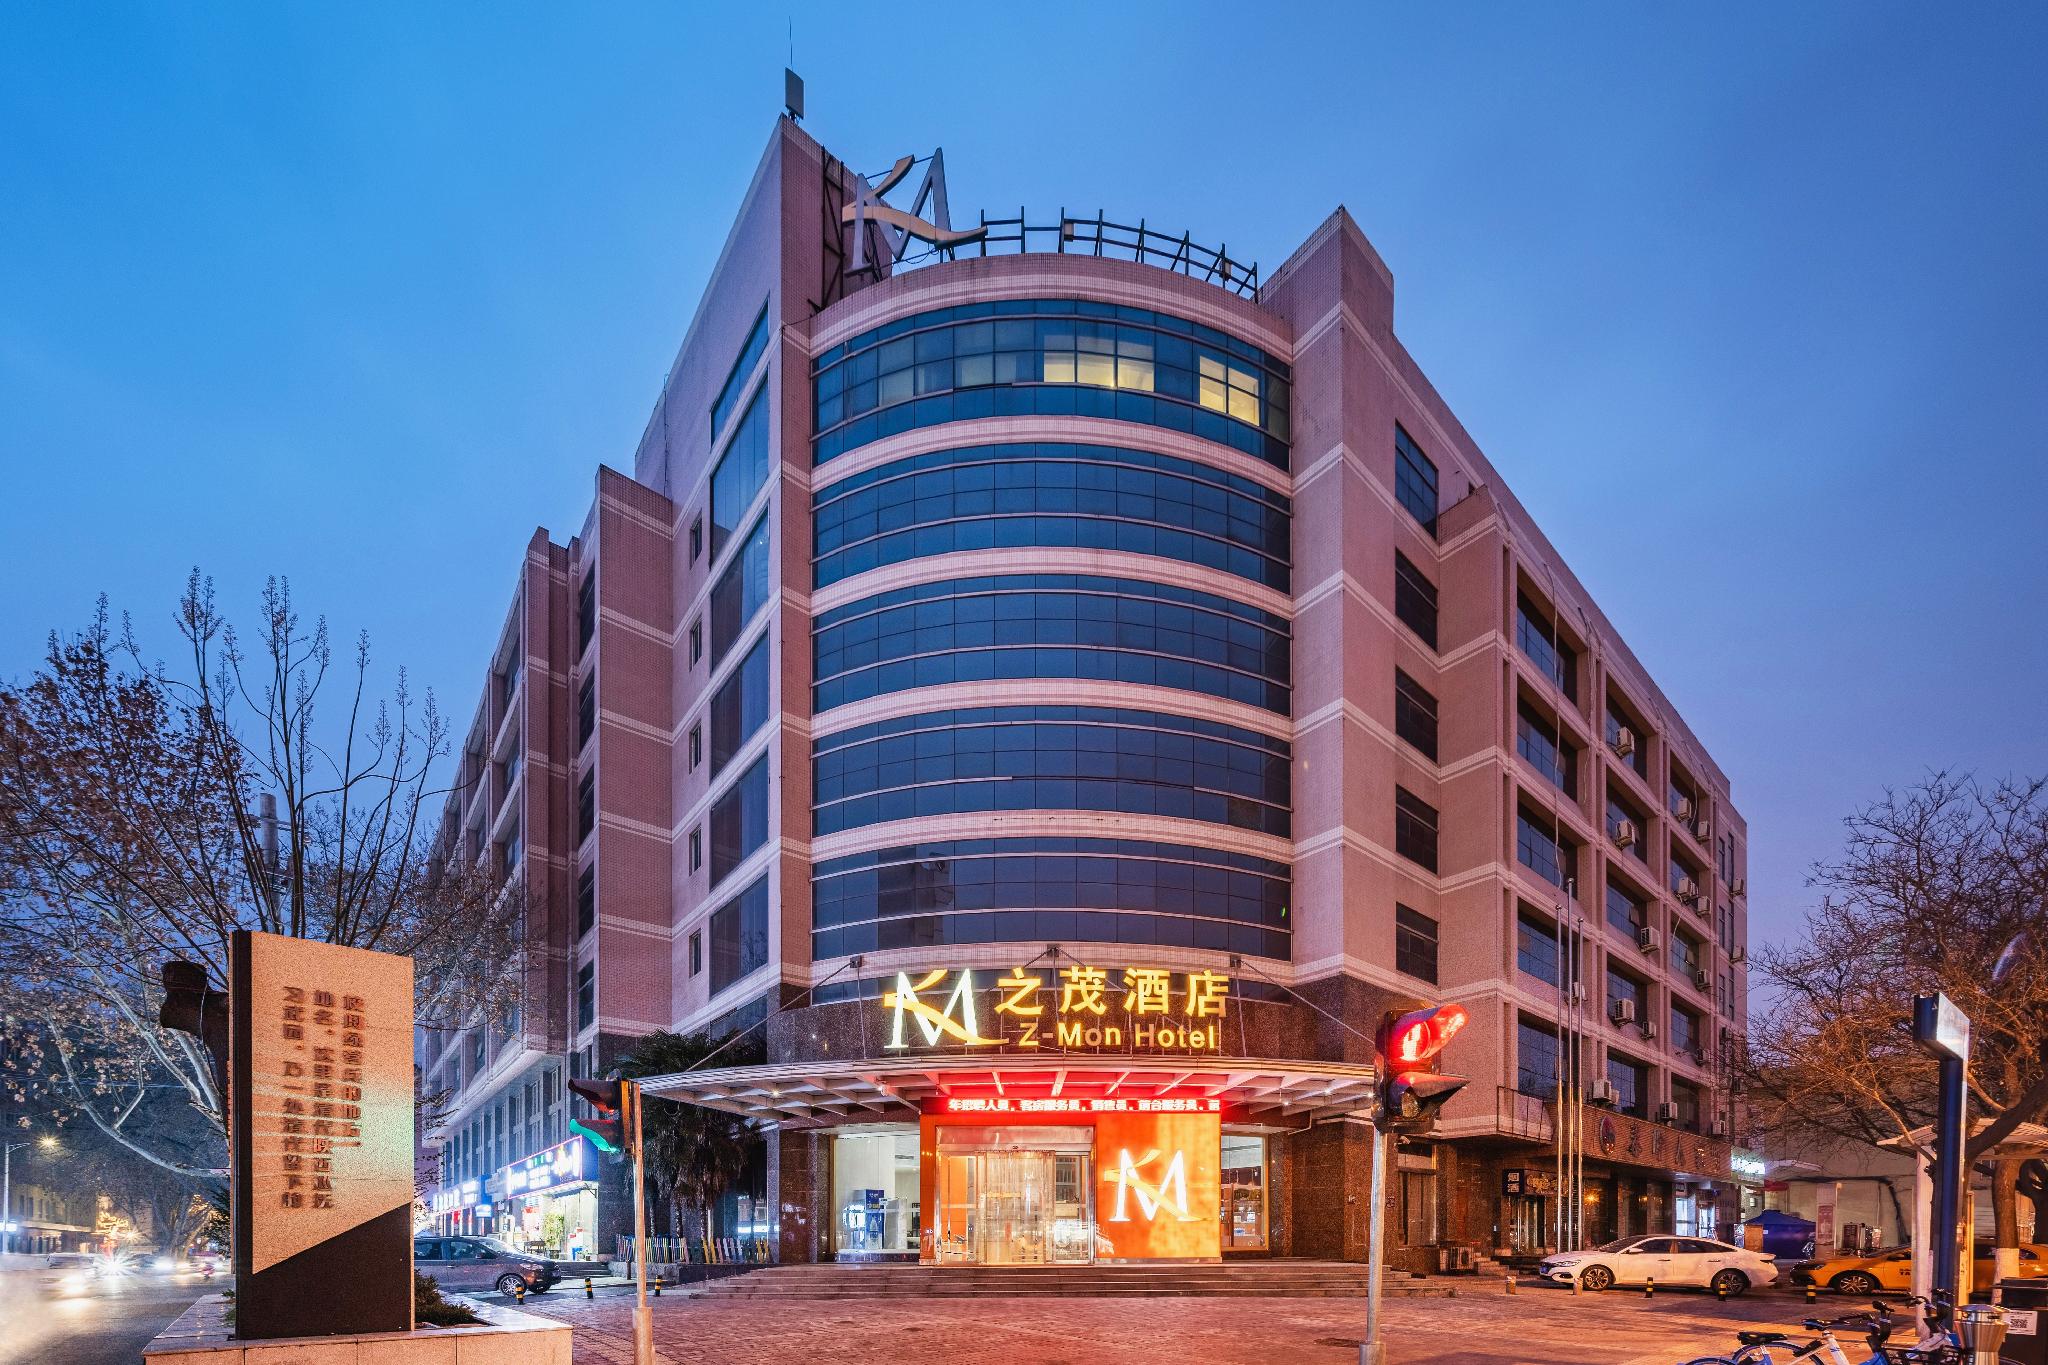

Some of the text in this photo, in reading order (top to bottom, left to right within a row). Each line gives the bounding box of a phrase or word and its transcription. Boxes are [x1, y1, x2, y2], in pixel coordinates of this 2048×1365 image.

[994, 967, 1230, 1018] 之茂酒店
[1019, 1022, 1215, 1049] Z-Mon Hotel
